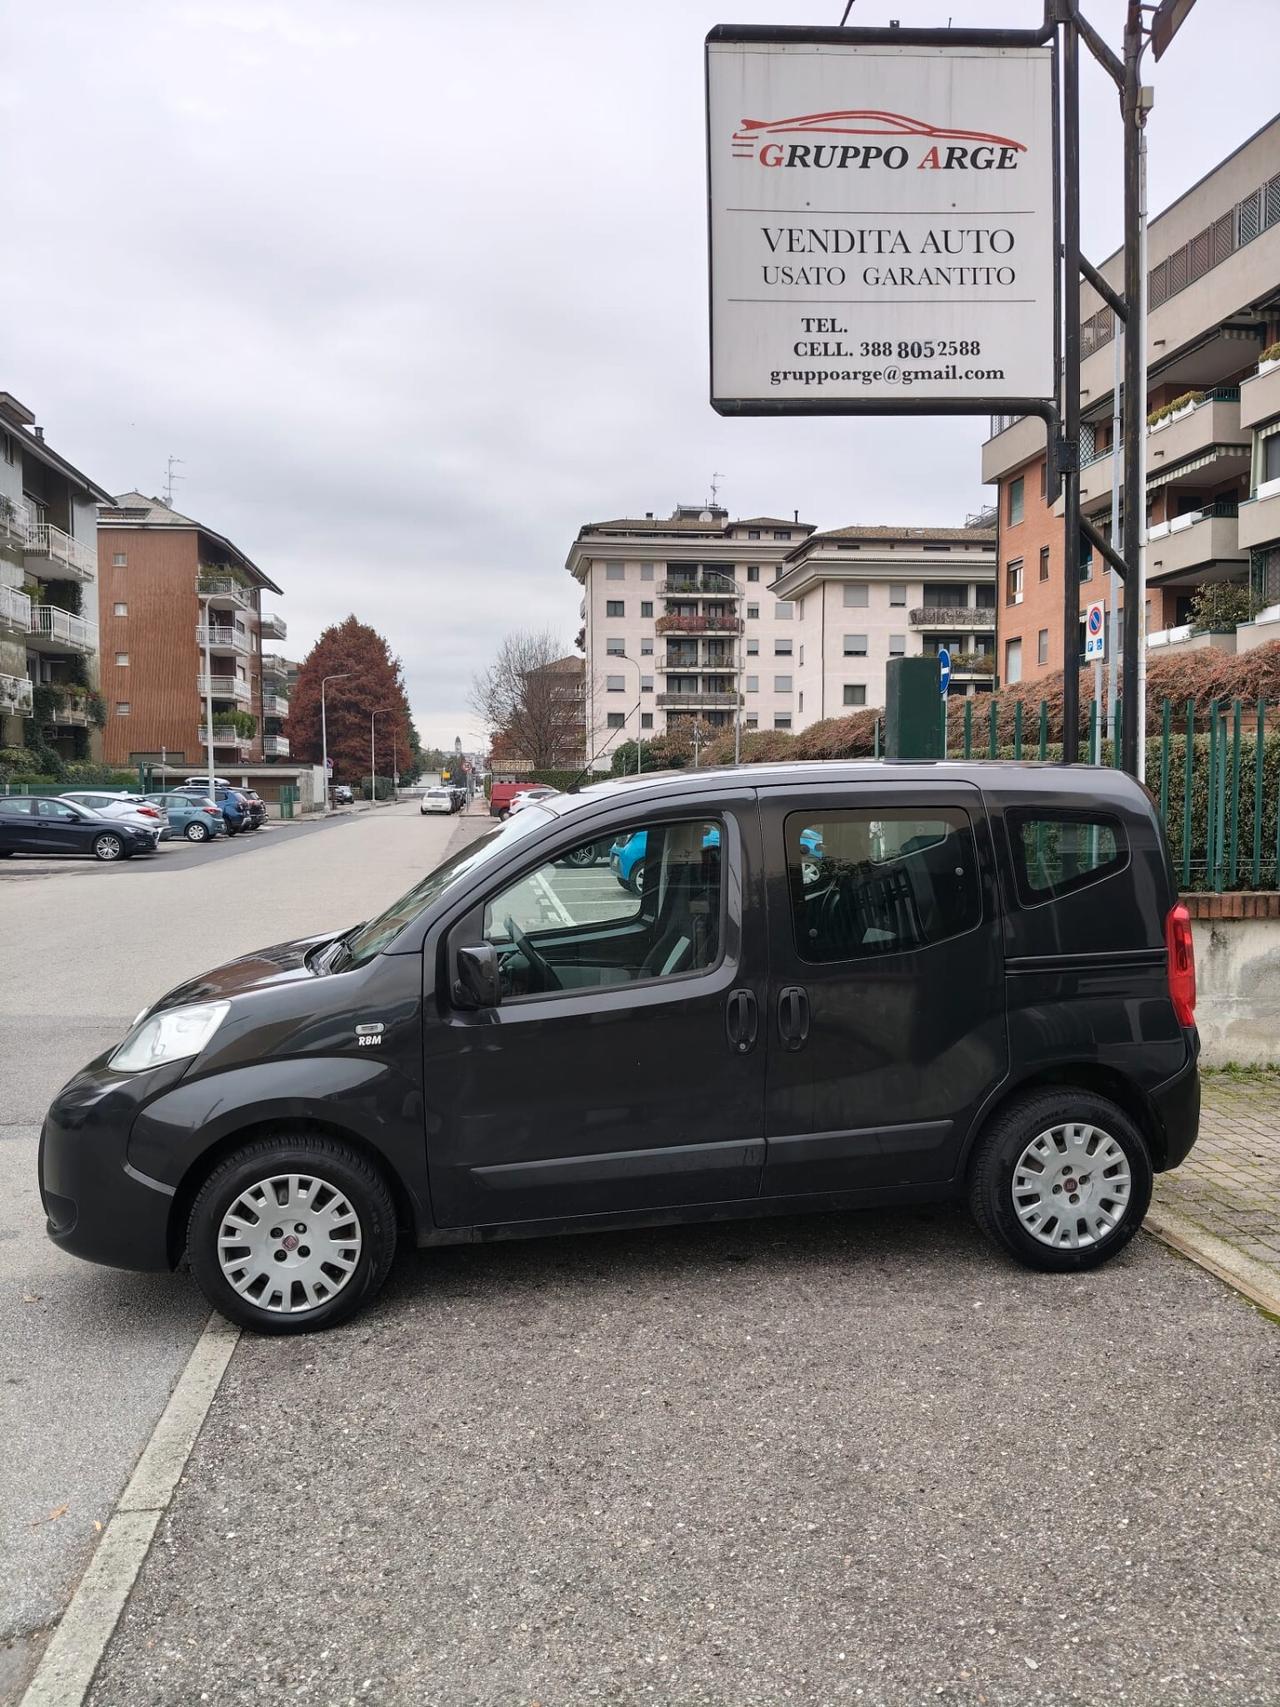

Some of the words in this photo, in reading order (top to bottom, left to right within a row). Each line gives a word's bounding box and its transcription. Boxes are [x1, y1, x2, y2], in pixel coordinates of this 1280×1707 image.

[759, 144, 909, 170] GRUPPO
[917, 145, 1020, 170] ARGE
[761, 227, 912, 254] VENDITA
[919, 229, 1015, 254] AUTO
[762, 266, 846, 286] USATO
[862, 266, 1016, 286] GARANTITO
[800, 317, 849, 333] TEL.
[793, 342, 854, 357] CELL.
[770, 365, 1005, 385] gruppoarge@gmail.com
